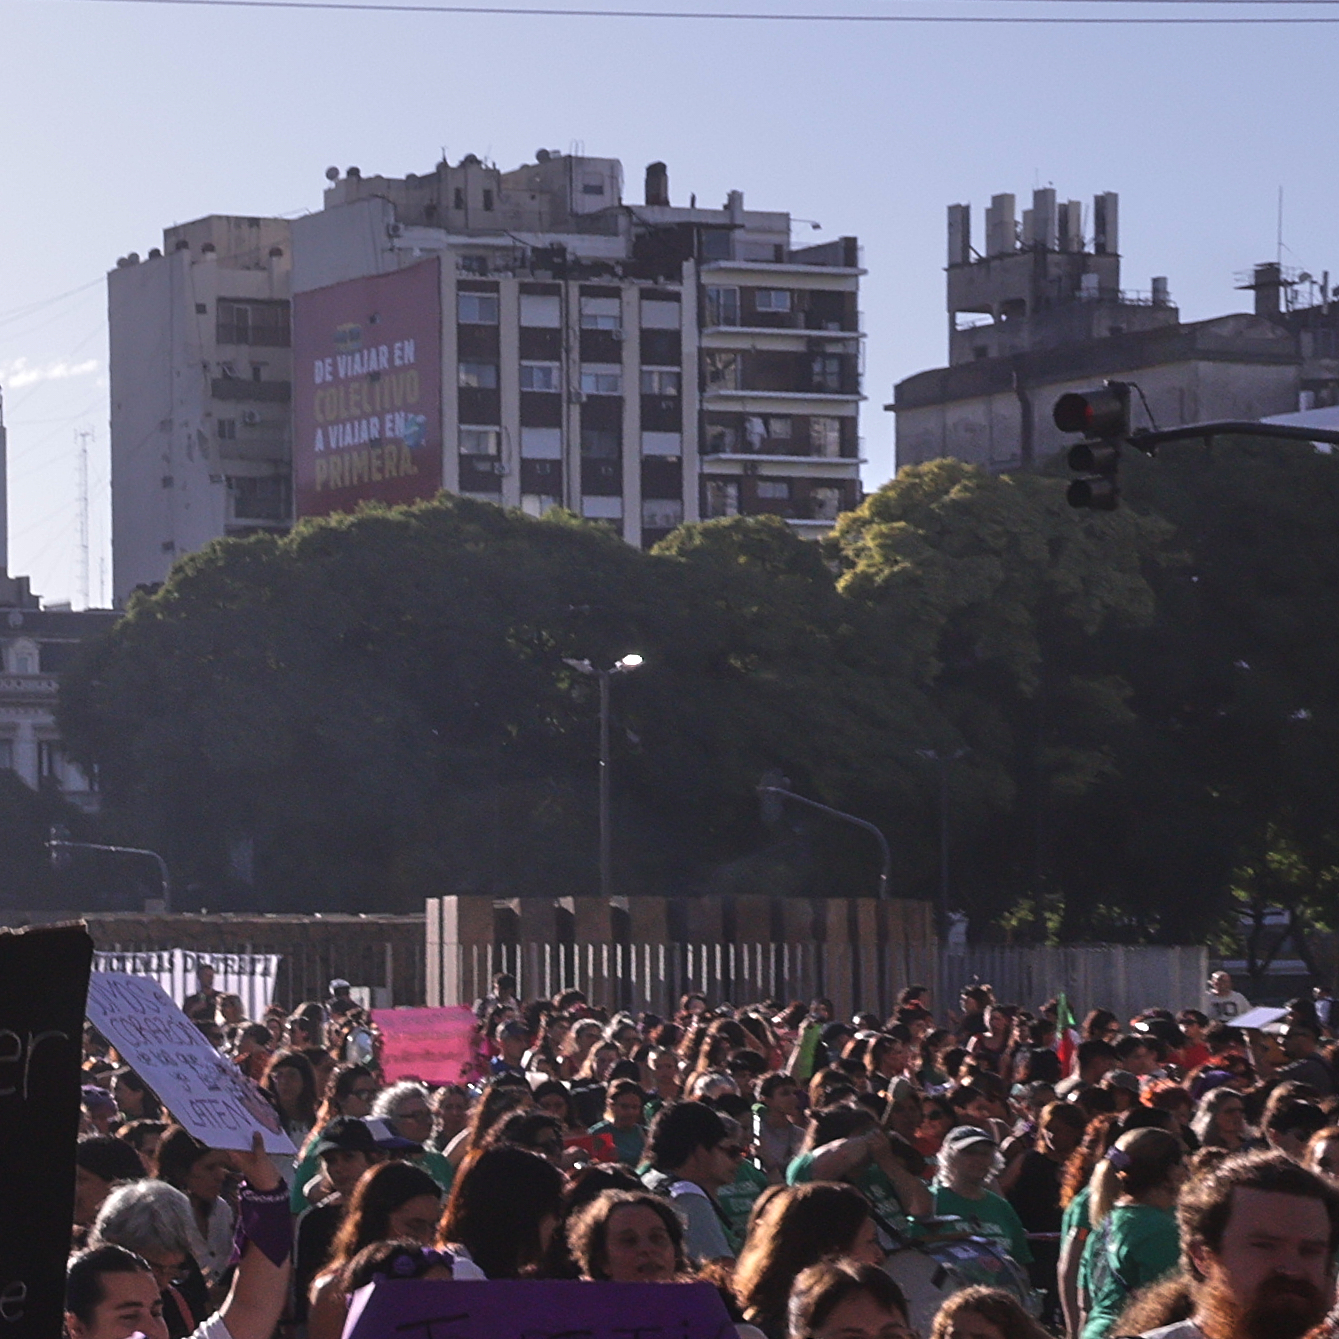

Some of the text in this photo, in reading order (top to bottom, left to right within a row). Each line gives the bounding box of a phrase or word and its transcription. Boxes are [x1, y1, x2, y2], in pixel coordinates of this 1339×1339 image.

[313, 338, 415, 384] DE VIAJAR EN
[313, 368, 420, 423] COLECTIVO
[314, 411, 407, 452] A VIAJAR EN
[185, 1098, 253, 1131] LATEN
